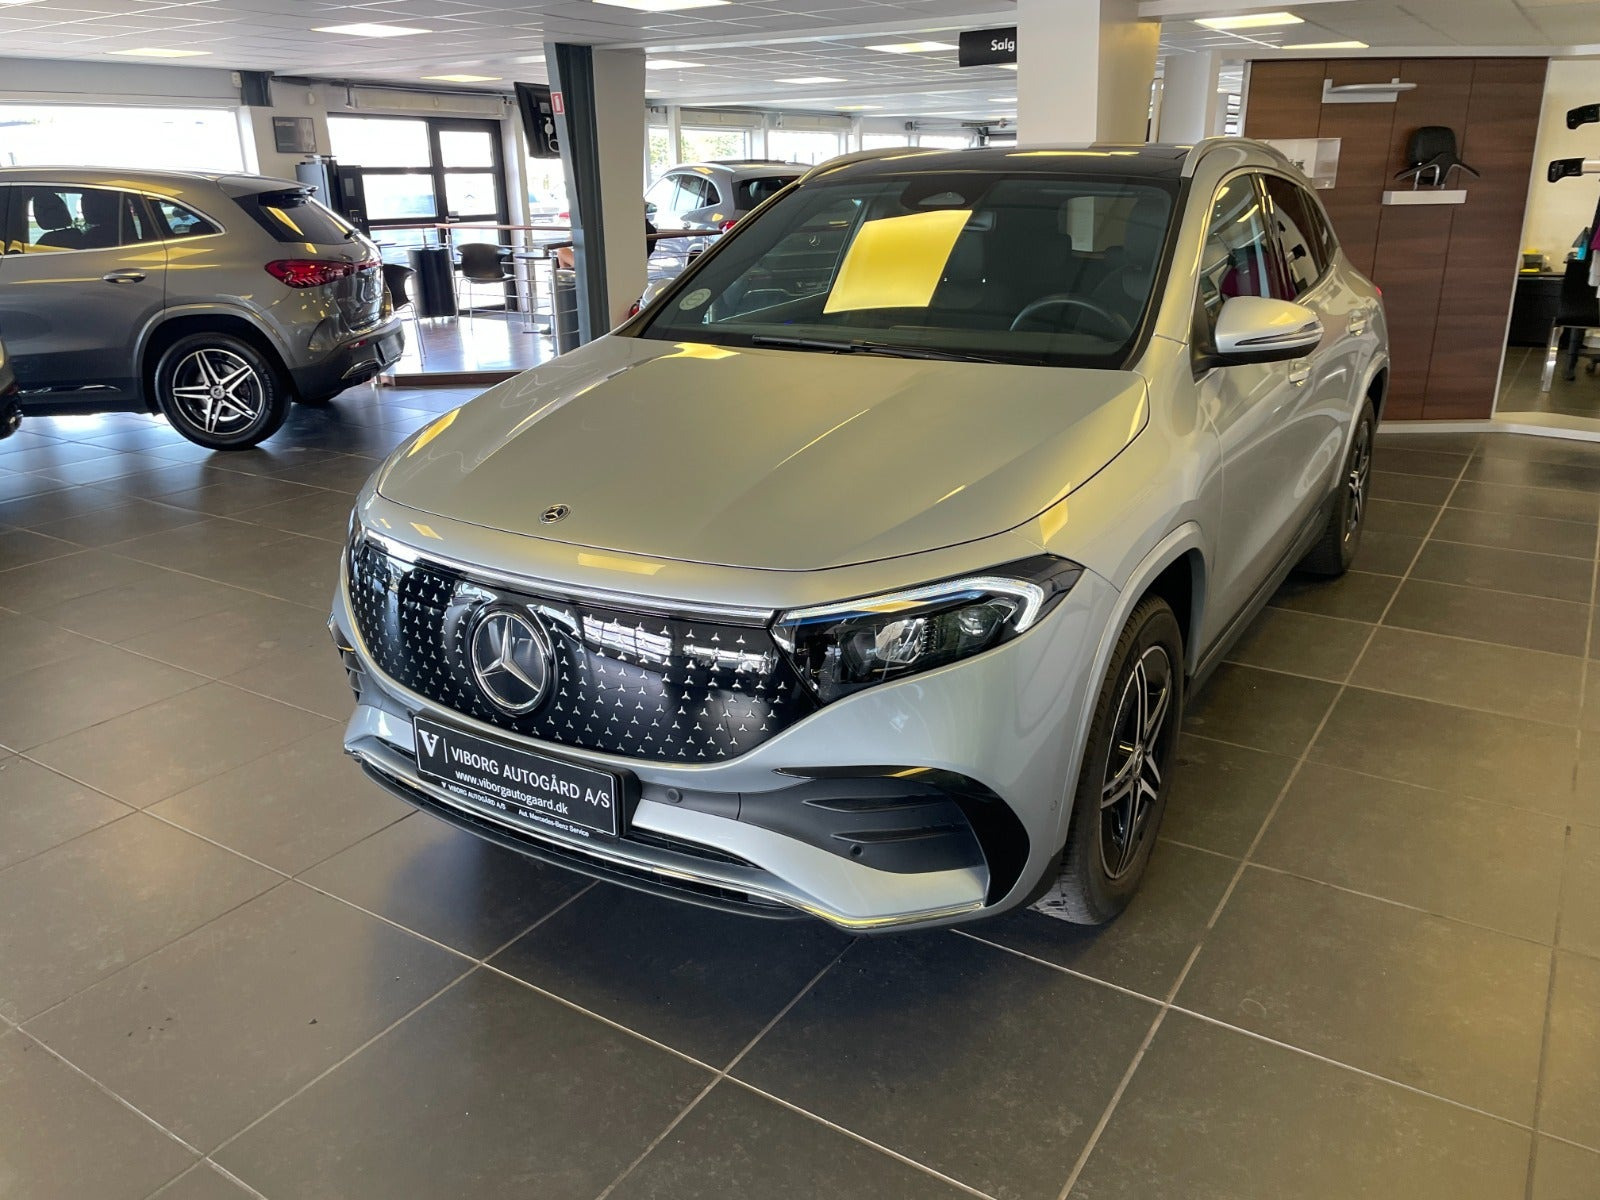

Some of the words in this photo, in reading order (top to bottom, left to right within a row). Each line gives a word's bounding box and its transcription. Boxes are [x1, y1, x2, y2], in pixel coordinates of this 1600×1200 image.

[990, 38, 1015, 52] Salg
[448, 784, 467, 796] VIBORG
[450, 746, 499, 775] VIBORG
[503, 764, 580, 798] AUTOGÅRD
[584, 788, 610, 808] A/S
[455, 770, 568, 815] www.viborgautogaard.dk
